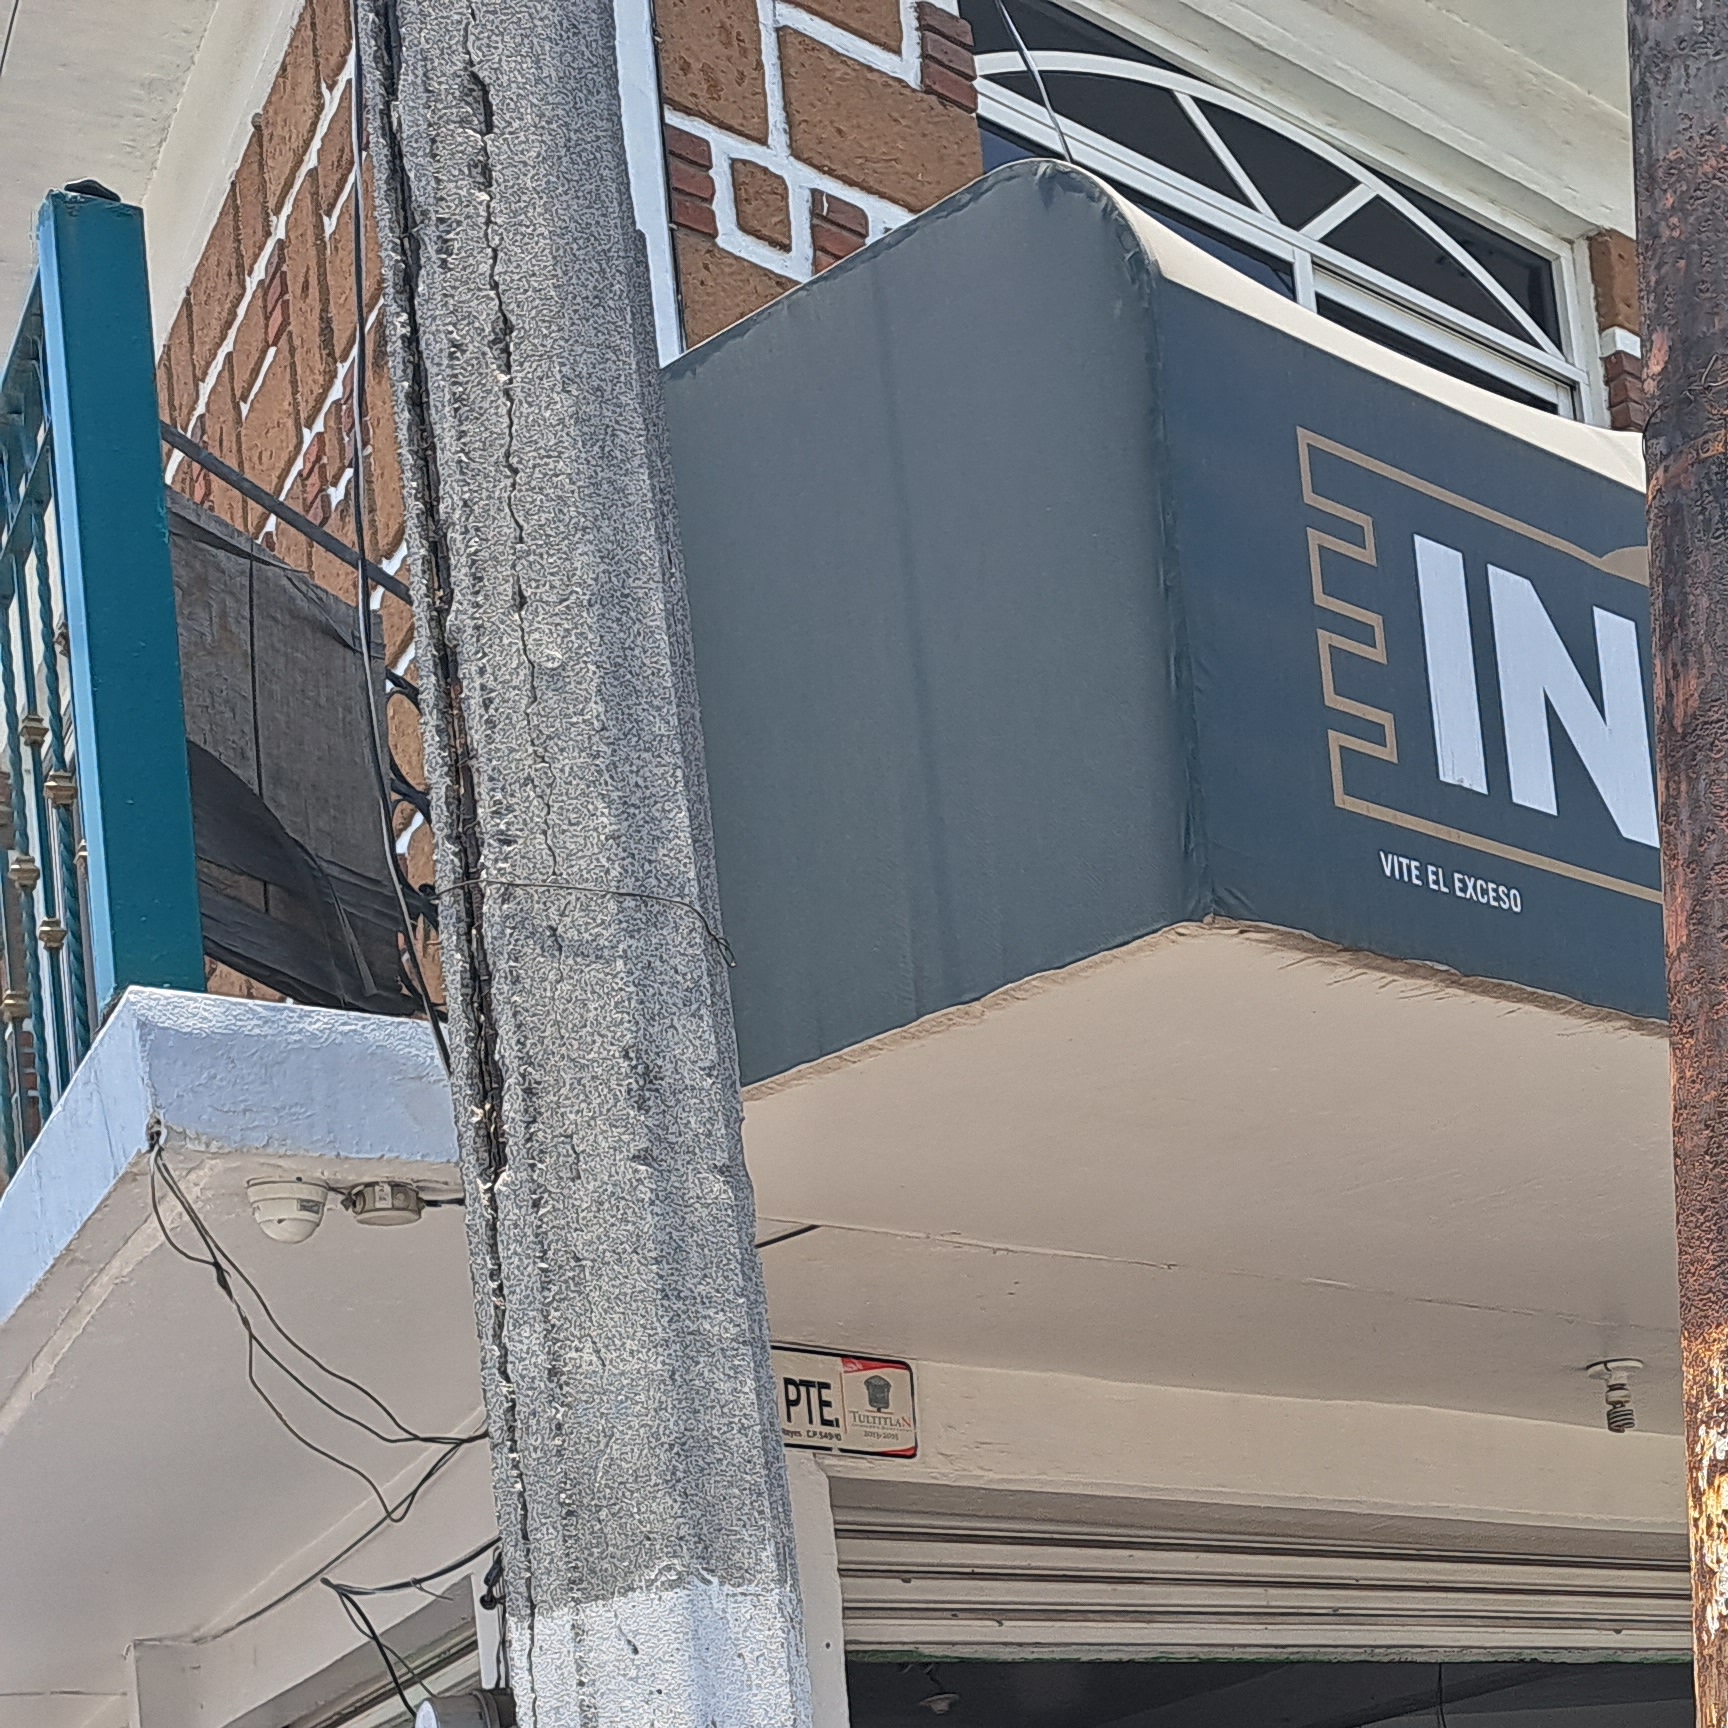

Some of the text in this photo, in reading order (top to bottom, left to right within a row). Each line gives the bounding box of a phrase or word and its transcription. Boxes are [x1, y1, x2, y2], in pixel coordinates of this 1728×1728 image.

[1379, 850, 1522, 913] VITE EL EXCESO
[783, 1377, 841, 1428] PTE.
